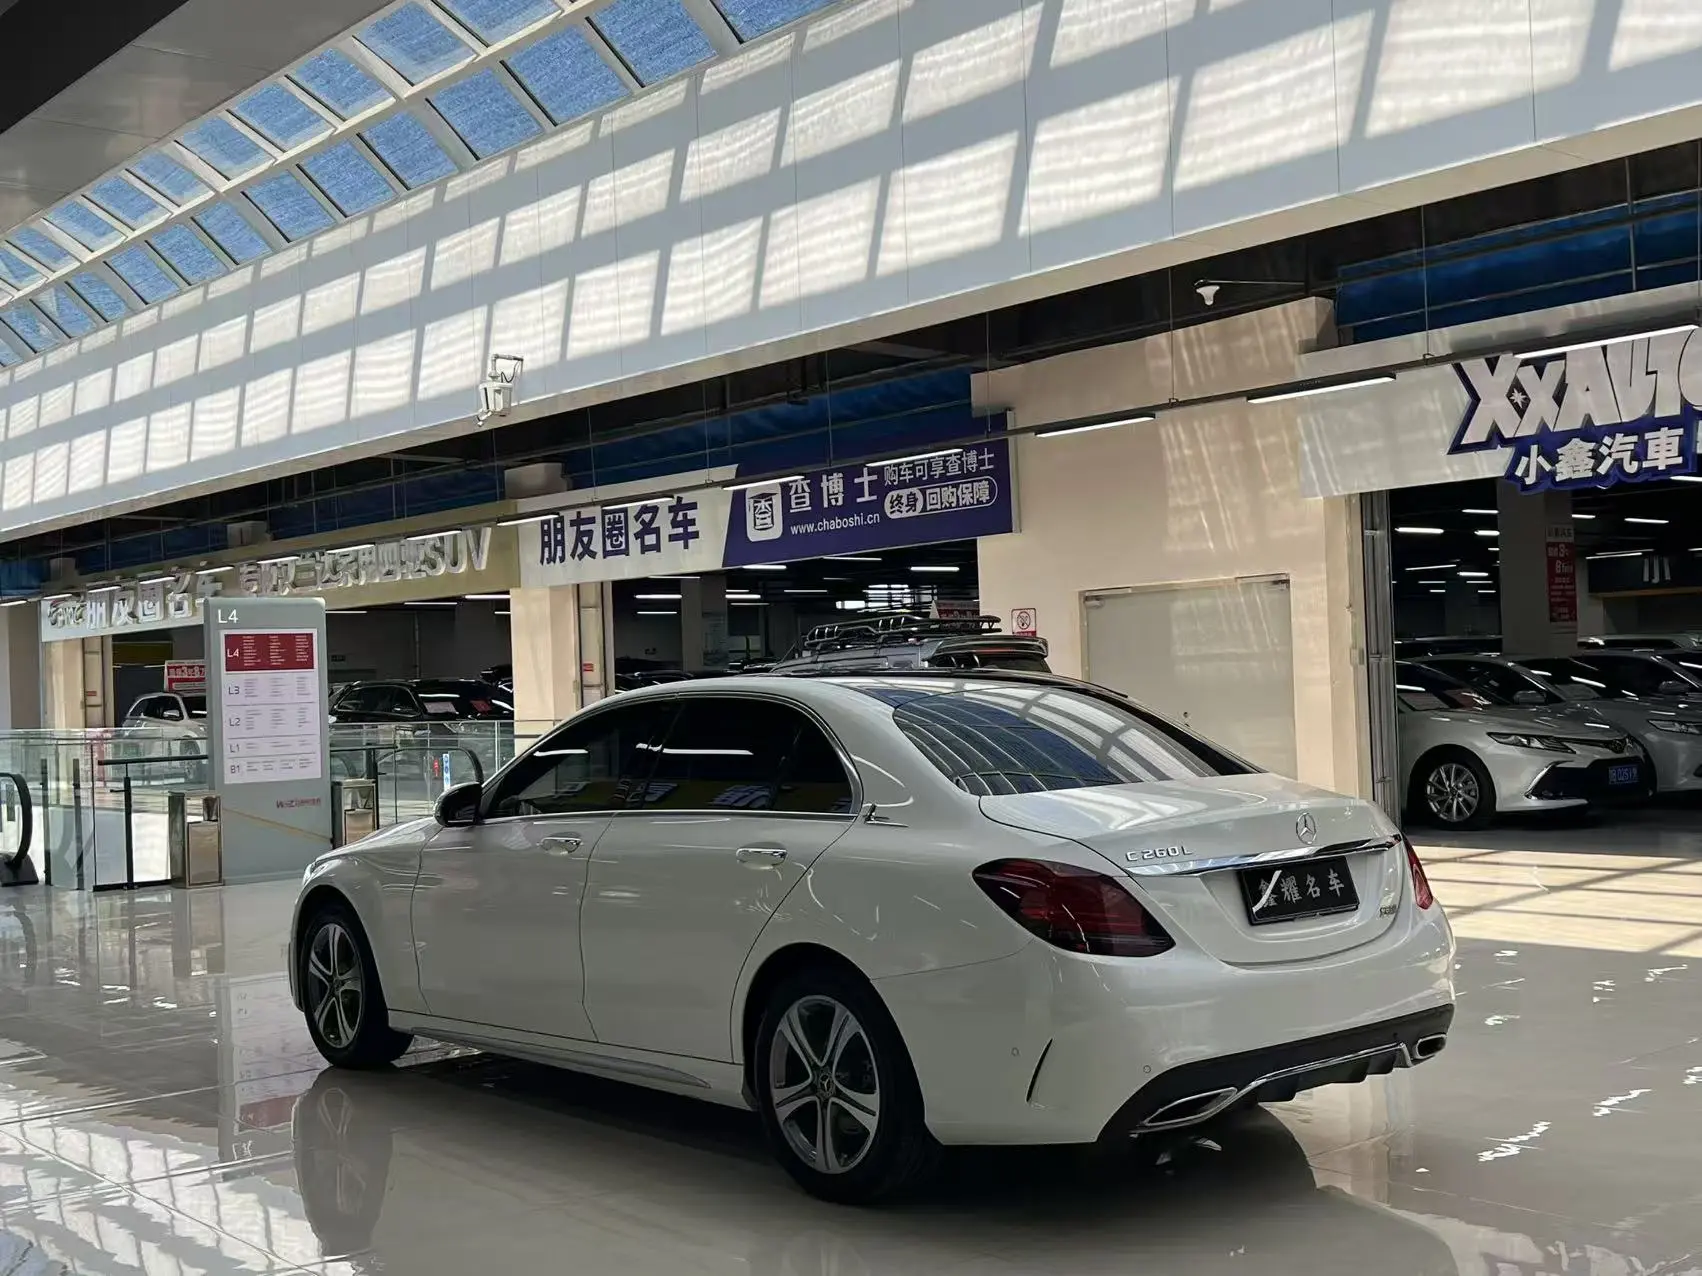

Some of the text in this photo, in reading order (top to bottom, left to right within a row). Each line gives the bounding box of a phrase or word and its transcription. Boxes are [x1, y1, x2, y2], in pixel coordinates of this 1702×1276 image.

[1515, 420, 1702, 486] 小鑫汽車
[884, 448, 995, 487] 购车可享查博士
[788, 467, 879, 513] 查博士
[889, 478, 990, 515] 终身 回购保障
[539, 496, 700, 566] 朋友圈名车
[790, 512, 880, 535] www.chaboshi.cn
[217, 608, 239, 624] L4
[226, 648, 239, 658] L4
[228, 685, 240, 695] L3
[228, 717, 241, 727] L2
[229, 744, 240, 753] L1
[230, 765, 241, 774] B1
